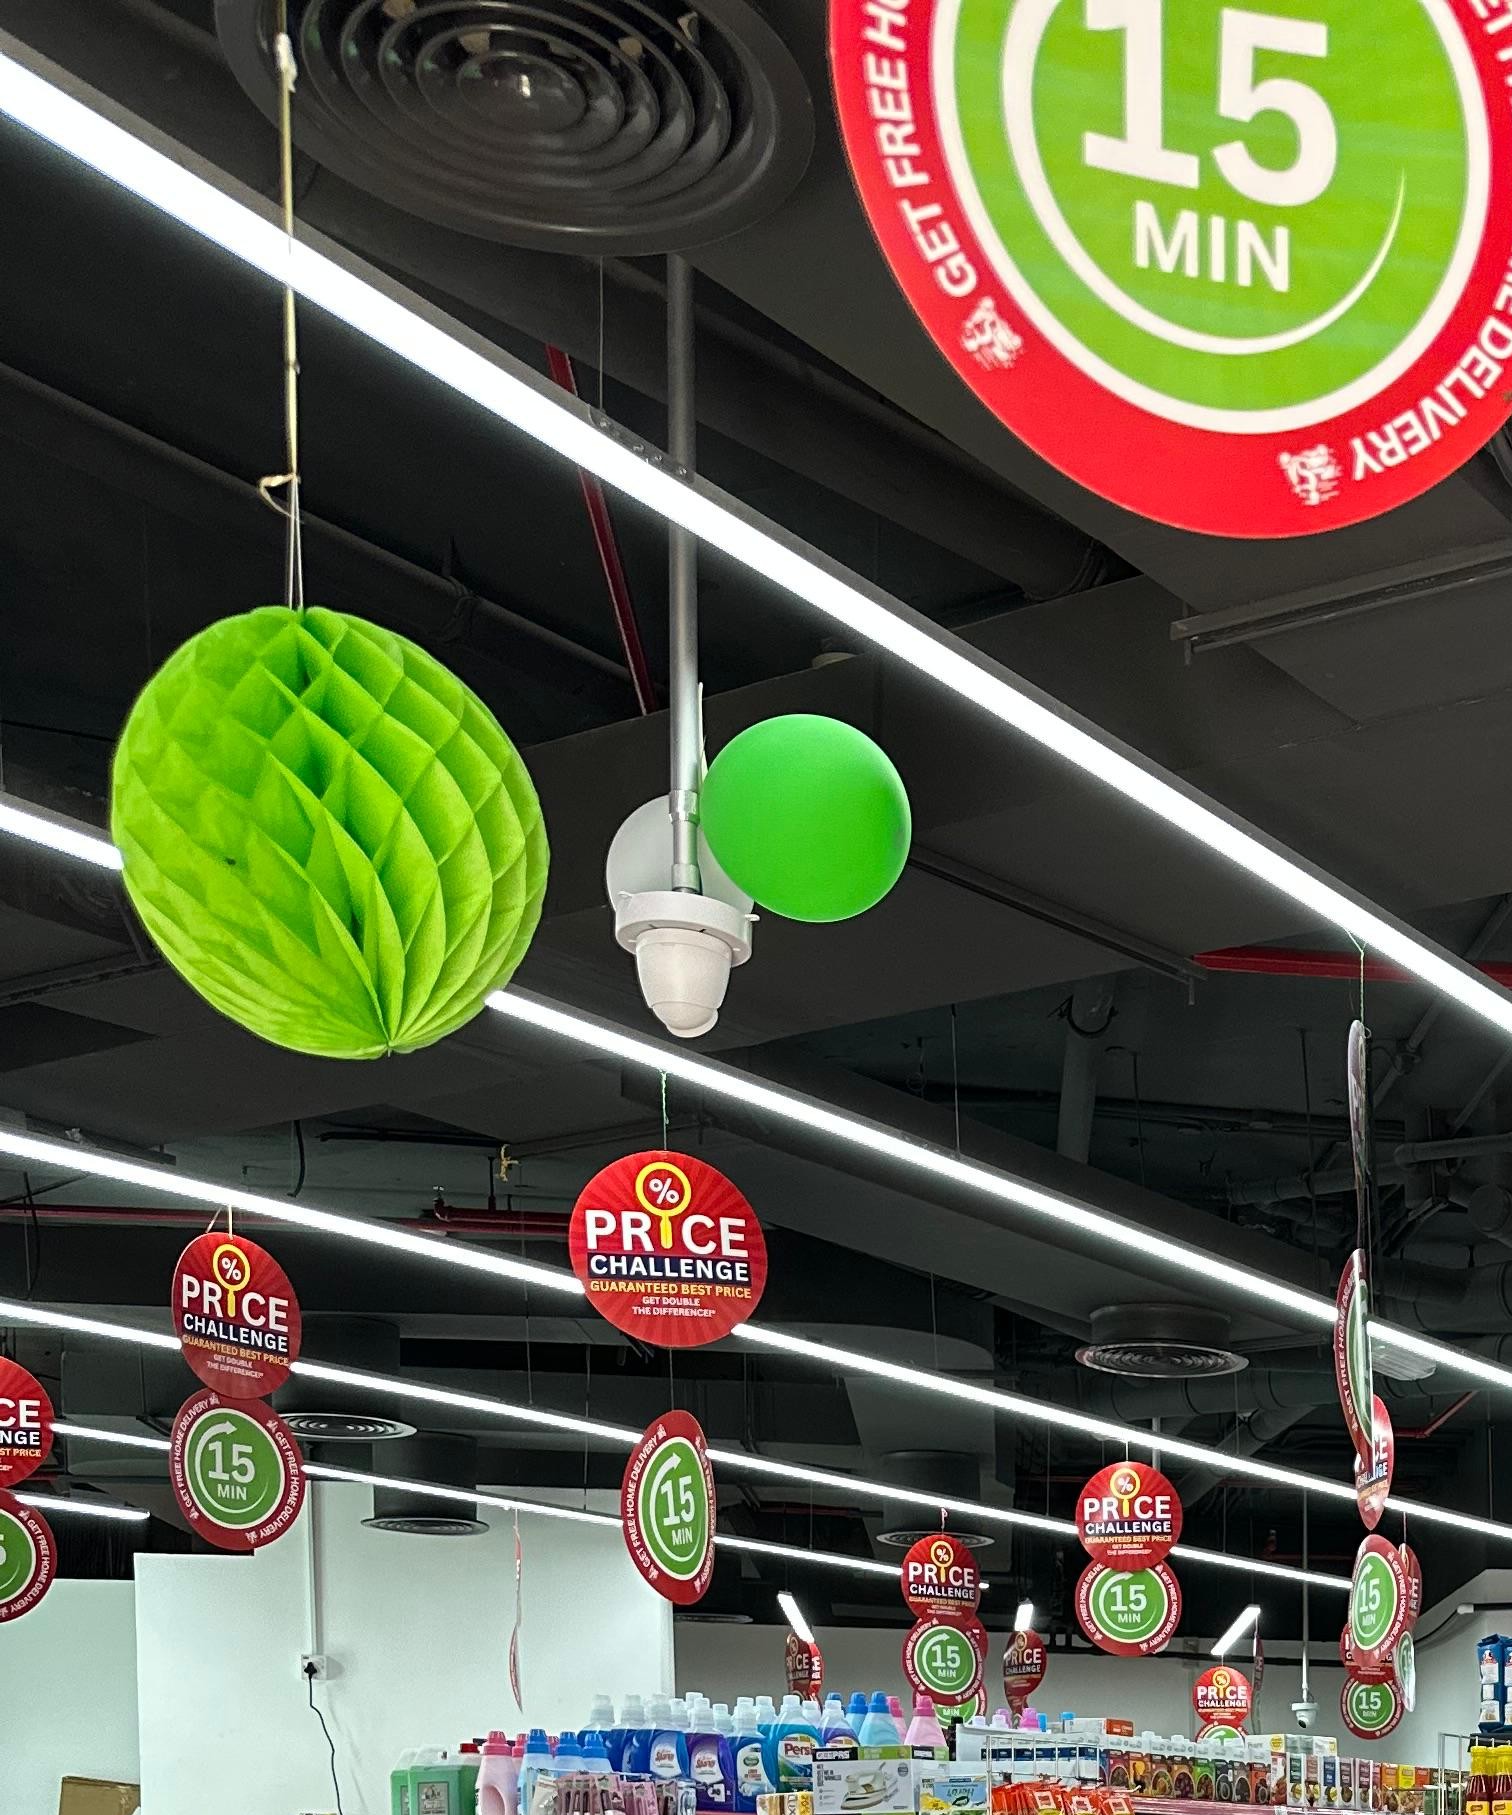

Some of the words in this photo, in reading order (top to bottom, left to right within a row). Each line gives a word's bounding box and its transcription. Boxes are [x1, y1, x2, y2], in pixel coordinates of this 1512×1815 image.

[1082, 0, 1338, 207] 15
[863, 52, 930, 188] FREE
[900, 200, 979, 298] GET
[1133, 201, 1291, 293] MIN
[585, 1209, 749, 1258] PRICE
[591, 1255, 750, 1281] CHALLENGE
[591, 1281, 679, 1294] GUARANTEED
[681, 1283, 712, 1297] BEST
[715, 1286, 751, 1299] PRICE
[642, 1297, 660, 1305] GET
[182, 1274, 289, 1332] PRICE
[632, 1306, 651, 1316] THE
[183, 1313, 288, 1352] CHALLENGE
[240, 1349, 261, 1361] BEST
[263, 1353, 289, 1366] PRICE
[13, 1449, 41, 1457] PRICE
[208, 1441, 255, 1483] 15
[275, 1432, 291, 1450] GET
[286, 1450, 299, 1478] FREE
[218, 1484, 247, 1500] MIN
[661, 1476, 695, 1526] 15
[1084, 1496, 1171, 1521] PRICE
[672, 1527, 693, 1546] MIN
[1085, 1521, 1171, 1534] CHALLENGE
[908, 1562, 975, 1588] PRICE
[910, 1584, 975, 1599] CHALLENGE
[1111, 1585, 1147, 1611] 15
[1360, 1578, 1380, 1613] 15
[1118, 1613, 1140, 1623] MIN
[931, 1645, 960, 1668] 15
[938, 1668, 956, 1678] MIN
[1198, 1685, 1247, 1700] PRICE
[1198, 1700, 1247, 1708] CHALLENGE
[1359, 1691, 1381, 1710] 15
